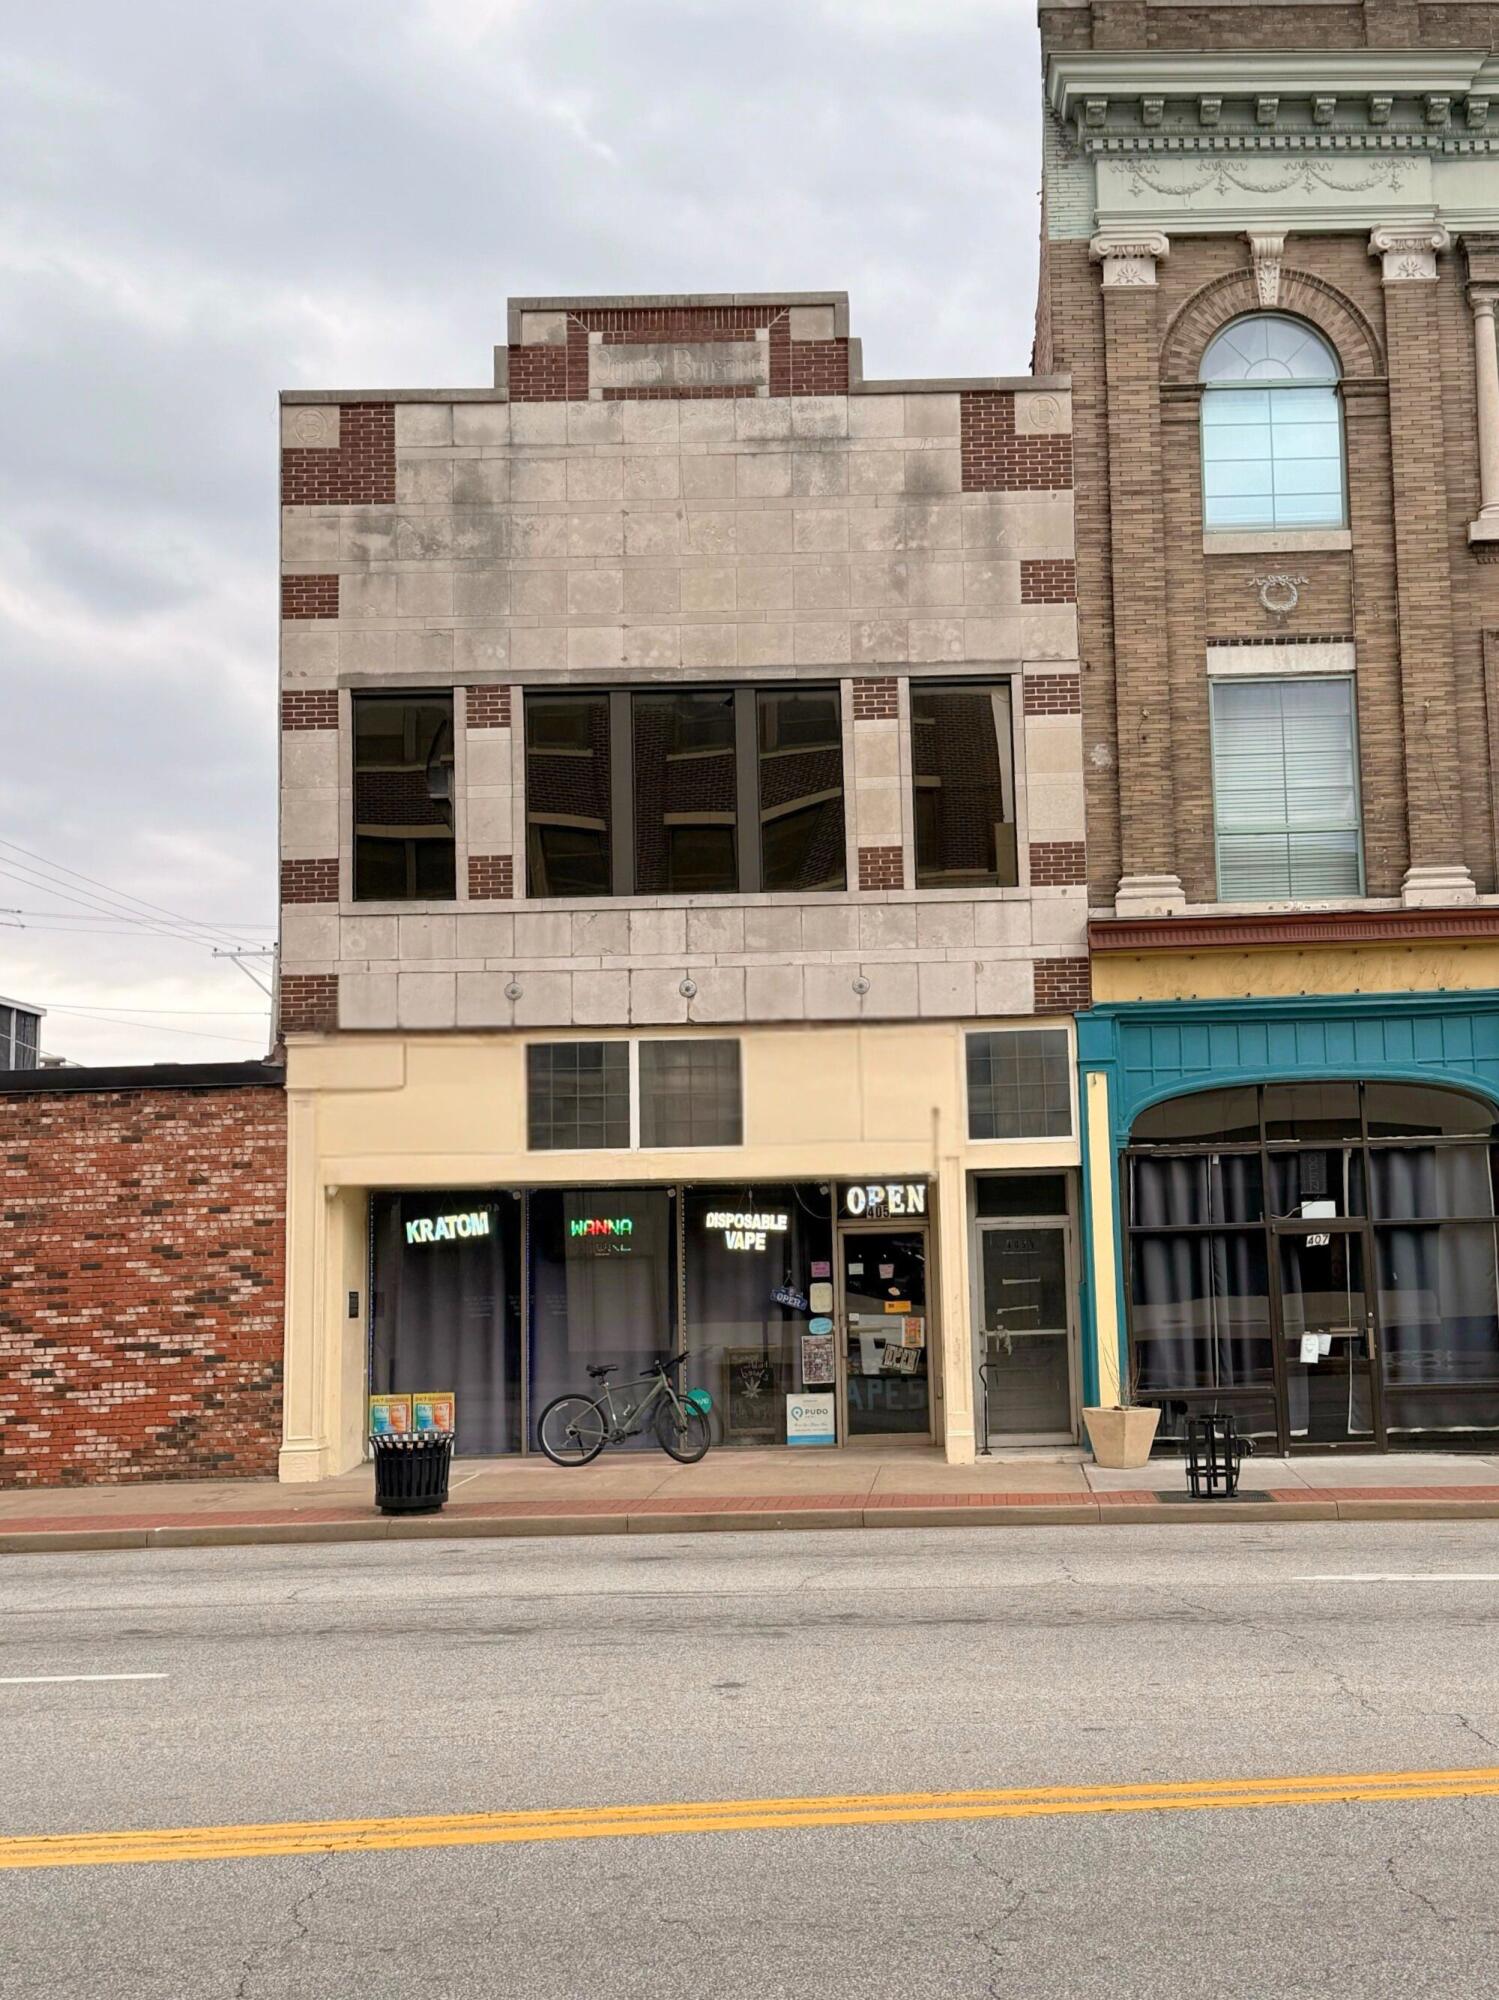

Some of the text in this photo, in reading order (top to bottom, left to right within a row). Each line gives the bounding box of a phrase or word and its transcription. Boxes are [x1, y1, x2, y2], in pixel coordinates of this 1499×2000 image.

[847, 1184, 926, 1215] OPEN
[706, 1212, 788, 1230] DISPOSABLE
[867, 1205, 890, 1218] 405
[406, 1211, 490, 1244] KRATOM
[571, 1218, 632, 1237] WANNA
[725, 1230, 767, 1250] VAPE
[1308, 1235, 1329, 1246] 407
